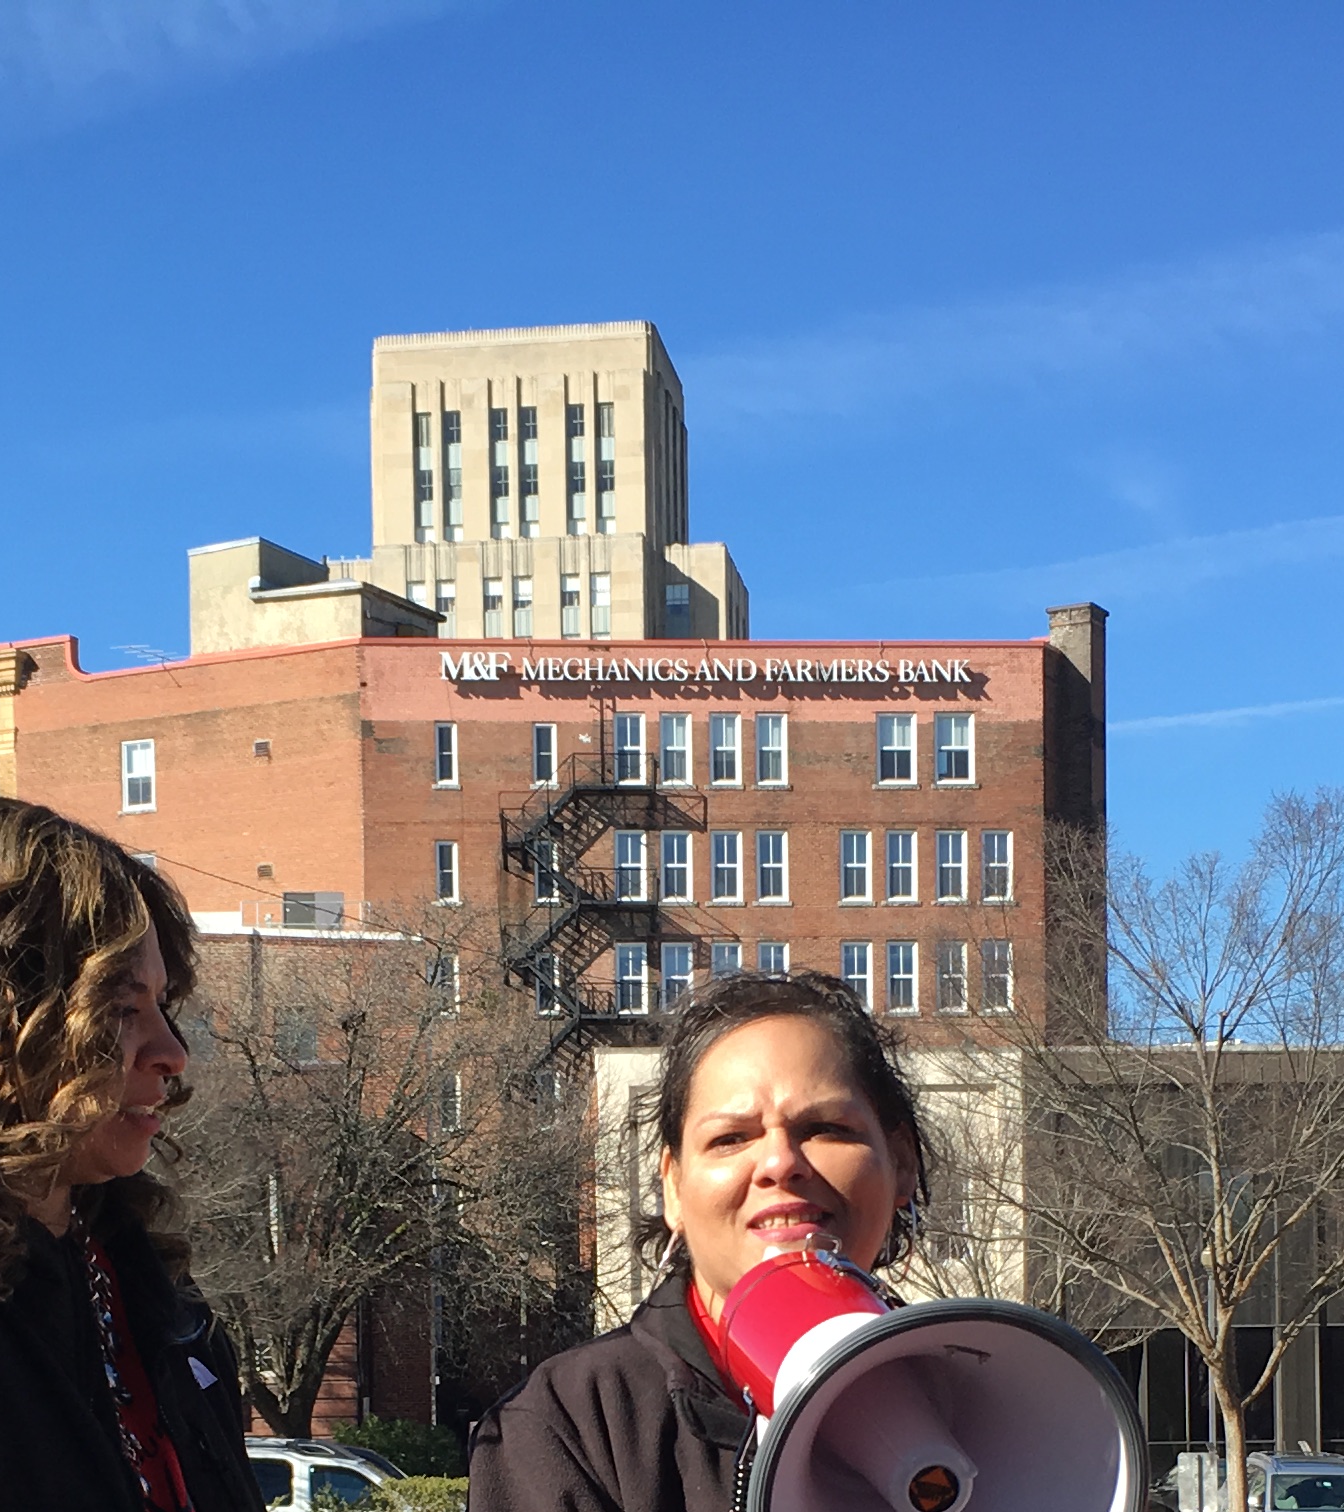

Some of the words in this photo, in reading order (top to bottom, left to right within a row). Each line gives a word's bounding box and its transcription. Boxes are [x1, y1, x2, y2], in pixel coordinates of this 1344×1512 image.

[439, 651, 512, 681] M&F
[521, 657, 688, 682] MECHANICS
[695, 658, 756, 682] AND
[765, 659, 890, 683] FARMERS
[898, 659, 972, 683] BANK
